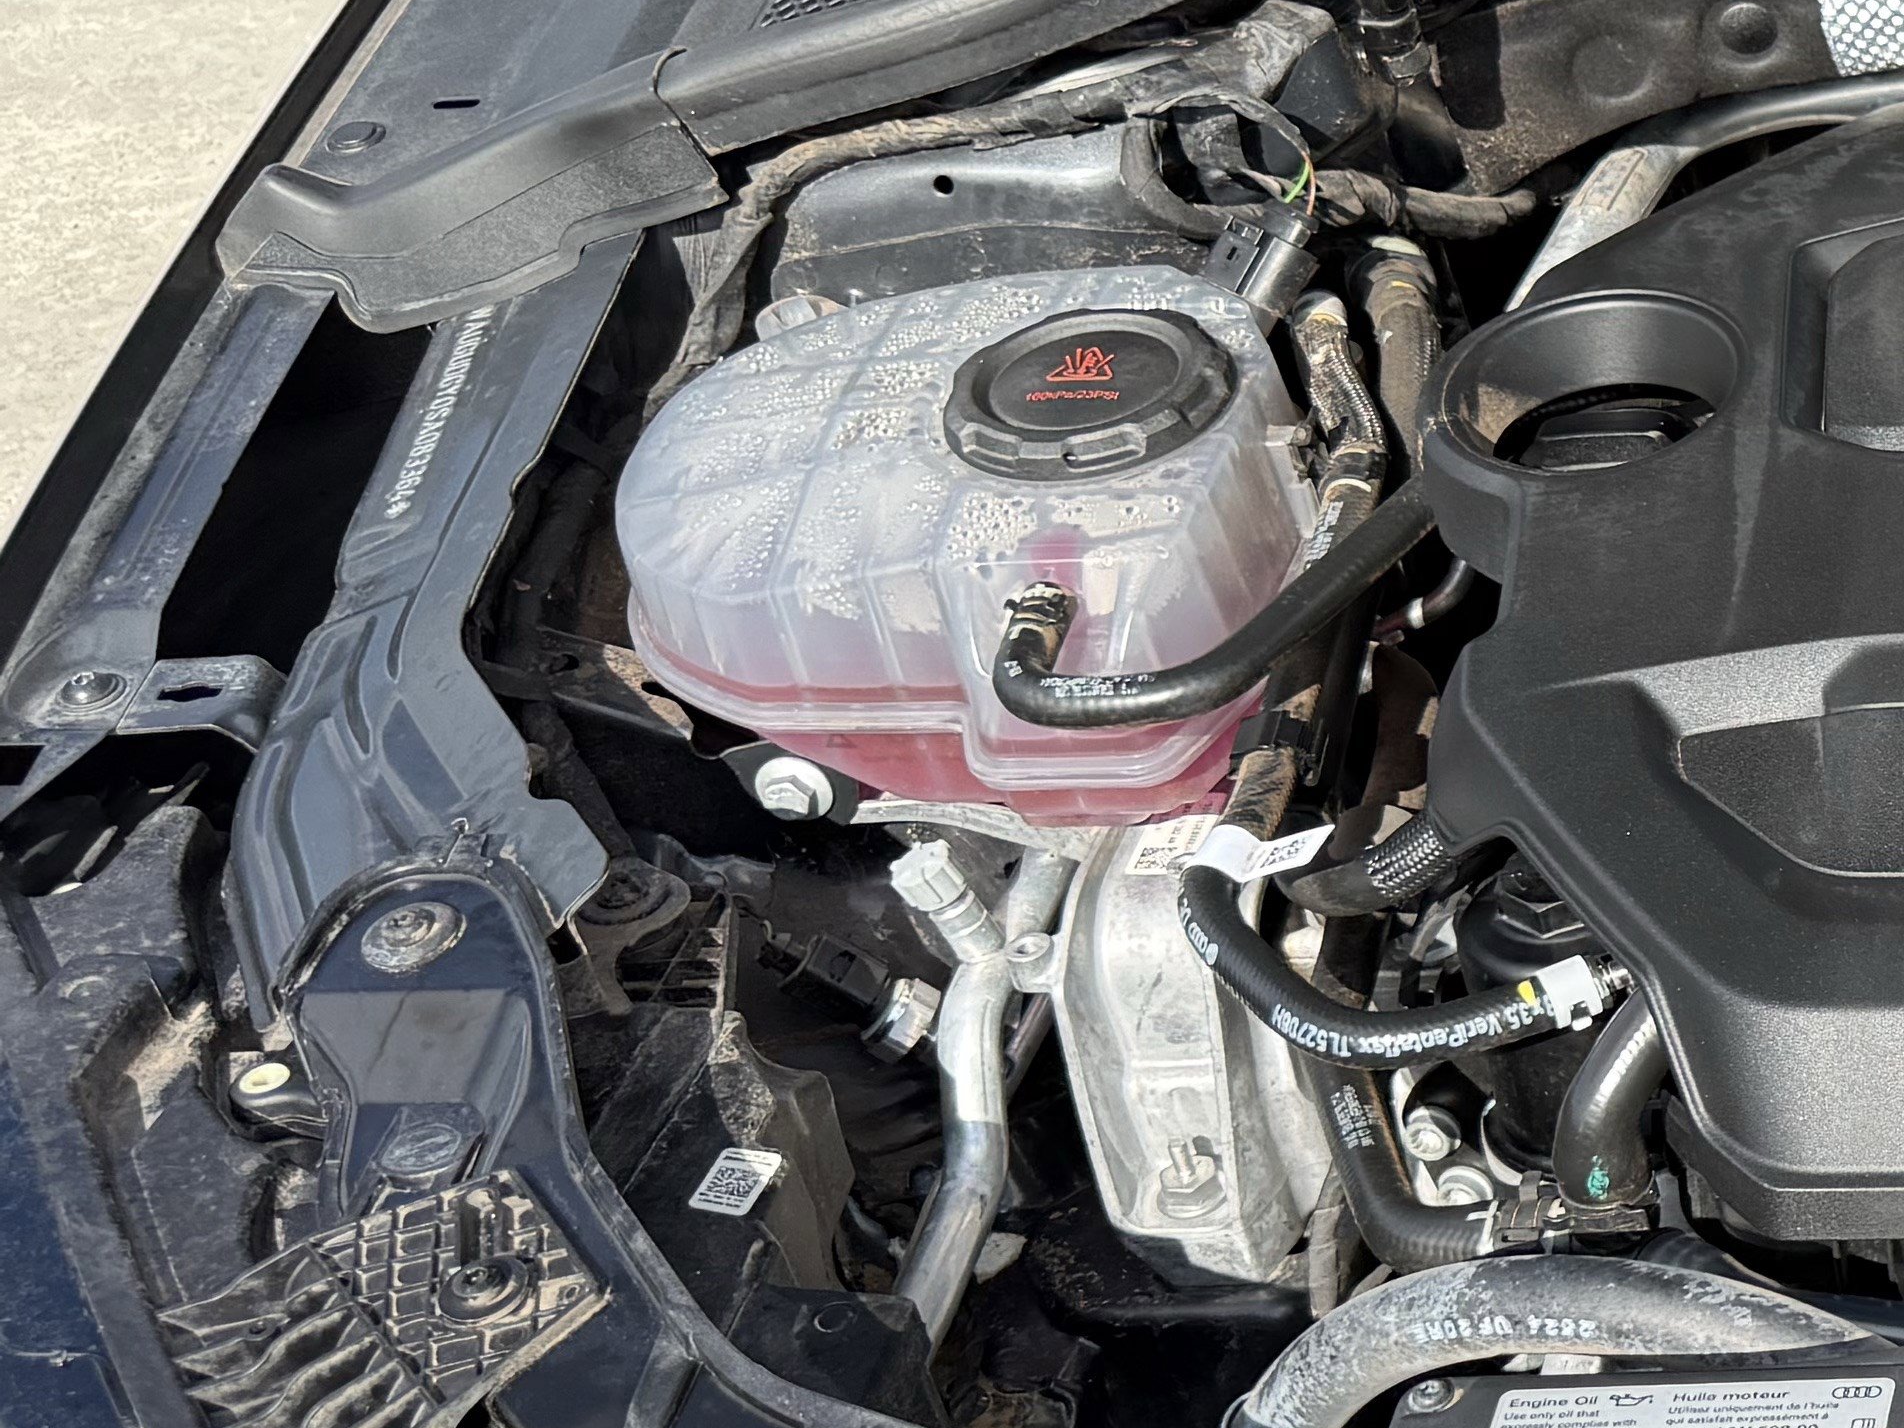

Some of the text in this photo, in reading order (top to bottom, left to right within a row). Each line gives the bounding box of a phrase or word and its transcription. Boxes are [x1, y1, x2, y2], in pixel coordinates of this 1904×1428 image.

[1723, 1390, 1791, 1400] moteur
[1510, 1395, 1598, 1409] Engine Oil
[1530, 1411, 1556, 1420] only
[1559, 1410, 1574, 1418] oil
[1577, 1410, 1600, 1418] that
[1612, 1419, 1637, 1427] with
